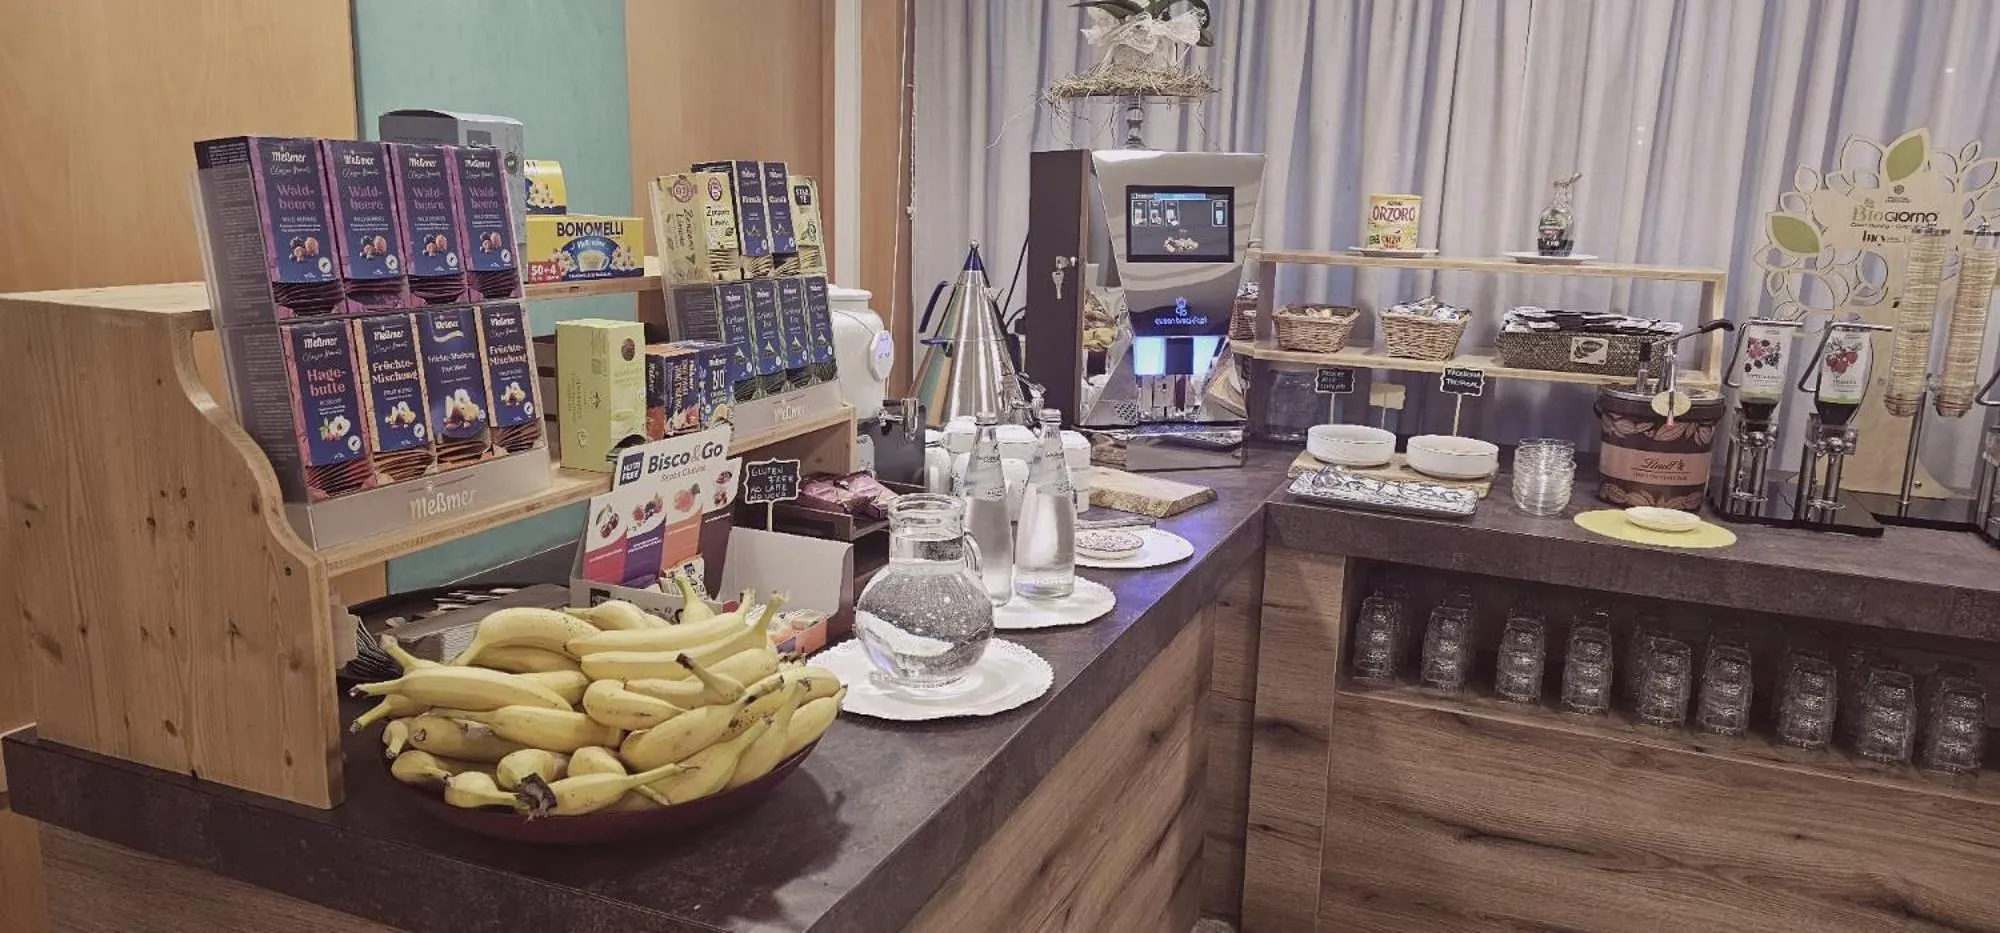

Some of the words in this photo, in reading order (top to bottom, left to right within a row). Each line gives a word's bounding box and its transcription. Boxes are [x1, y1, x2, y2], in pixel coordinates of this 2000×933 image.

[1372, 205, 1416, 221] ORZORO
[556, 221, 624, 237] BONOMELLI
[307, 368, 347, 383] Hage-
[622, 470, 639, 481] FREE
[751, 466, 784, 477] GLUTEN
[409, 489, 476, 519] Meßmer
